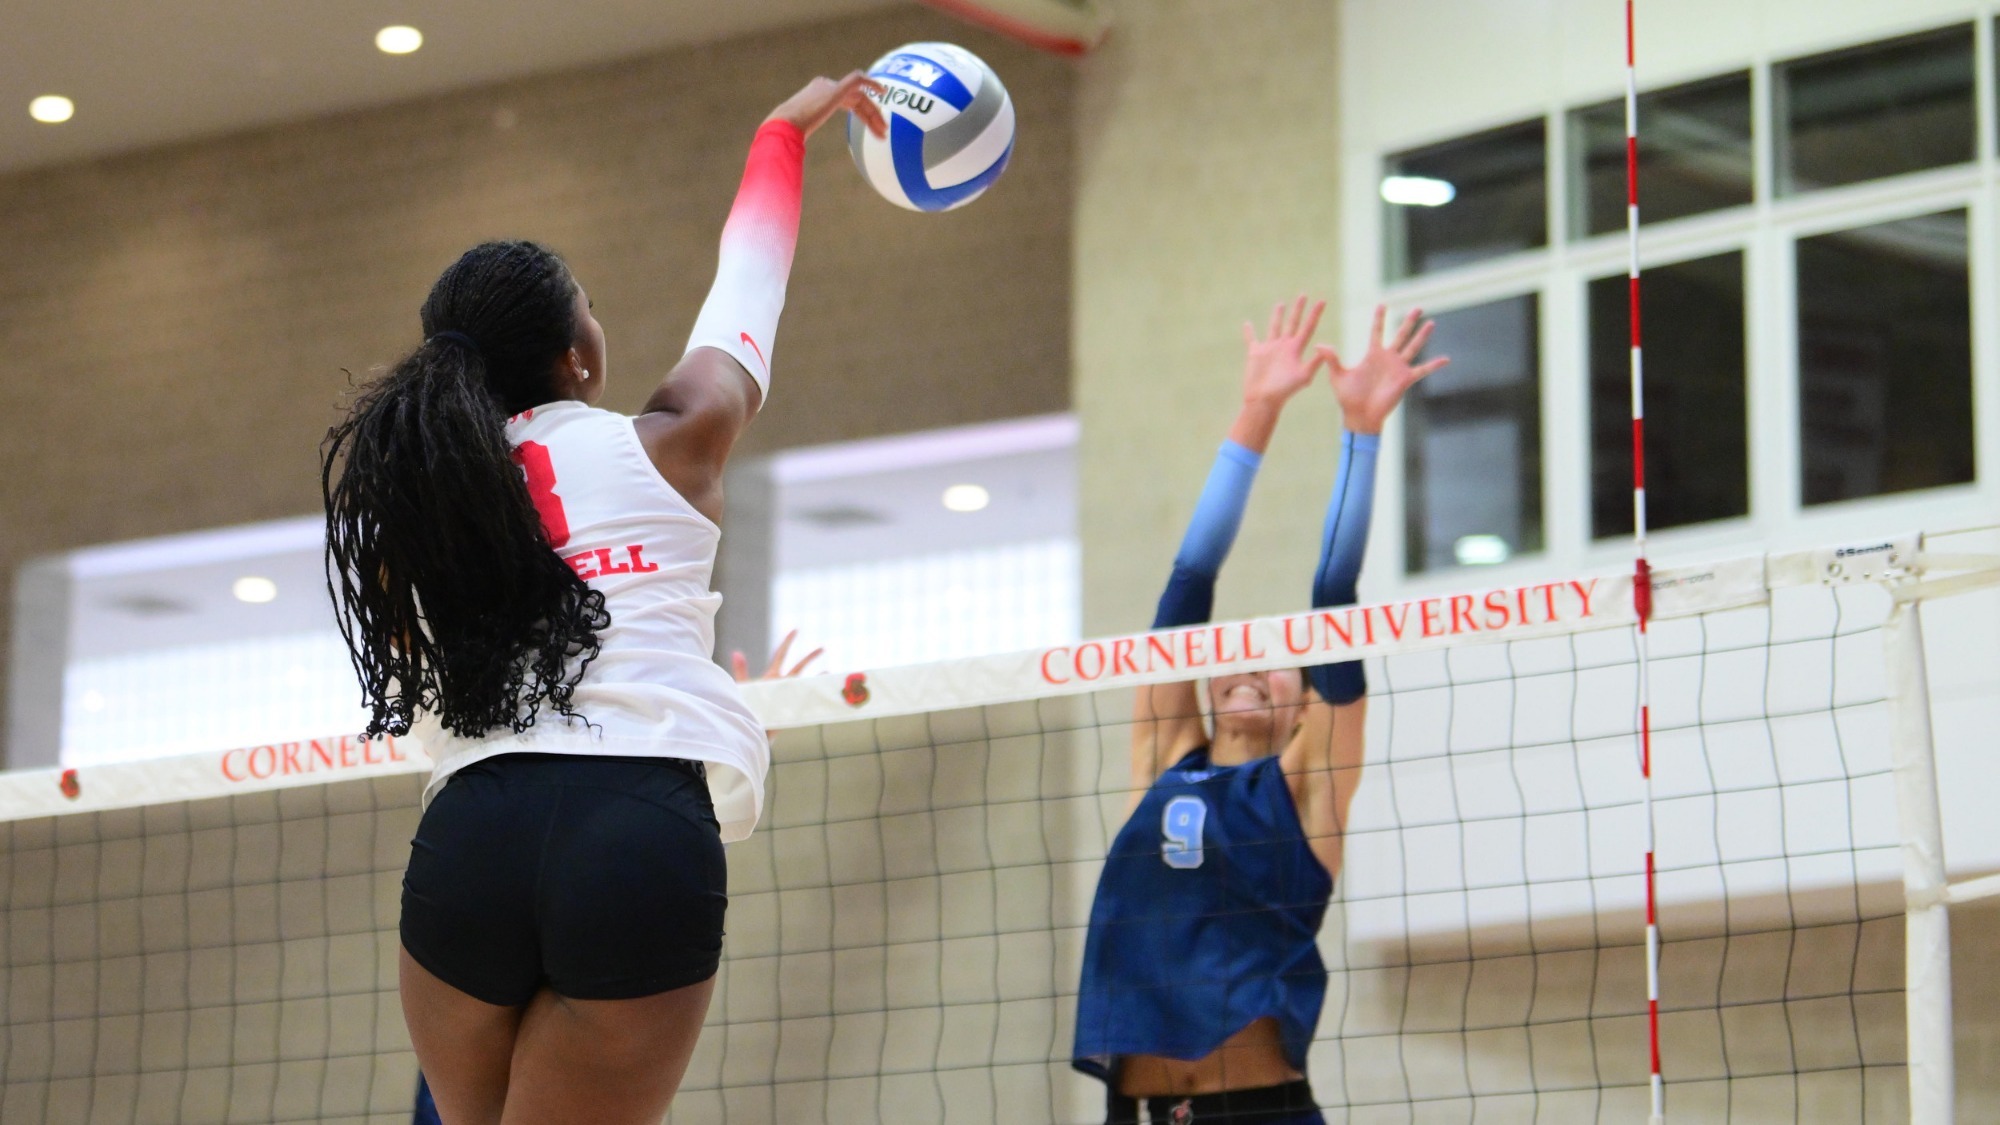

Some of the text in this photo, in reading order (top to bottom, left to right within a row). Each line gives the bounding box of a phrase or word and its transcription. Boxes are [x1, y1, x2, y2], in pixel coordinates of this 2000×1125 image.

[1040, 577, 1599, 685] CORNELL UNIVERSITY
[220, 735, 406, 782] CORNELL
[1161, 795, 1207, 869] 9
